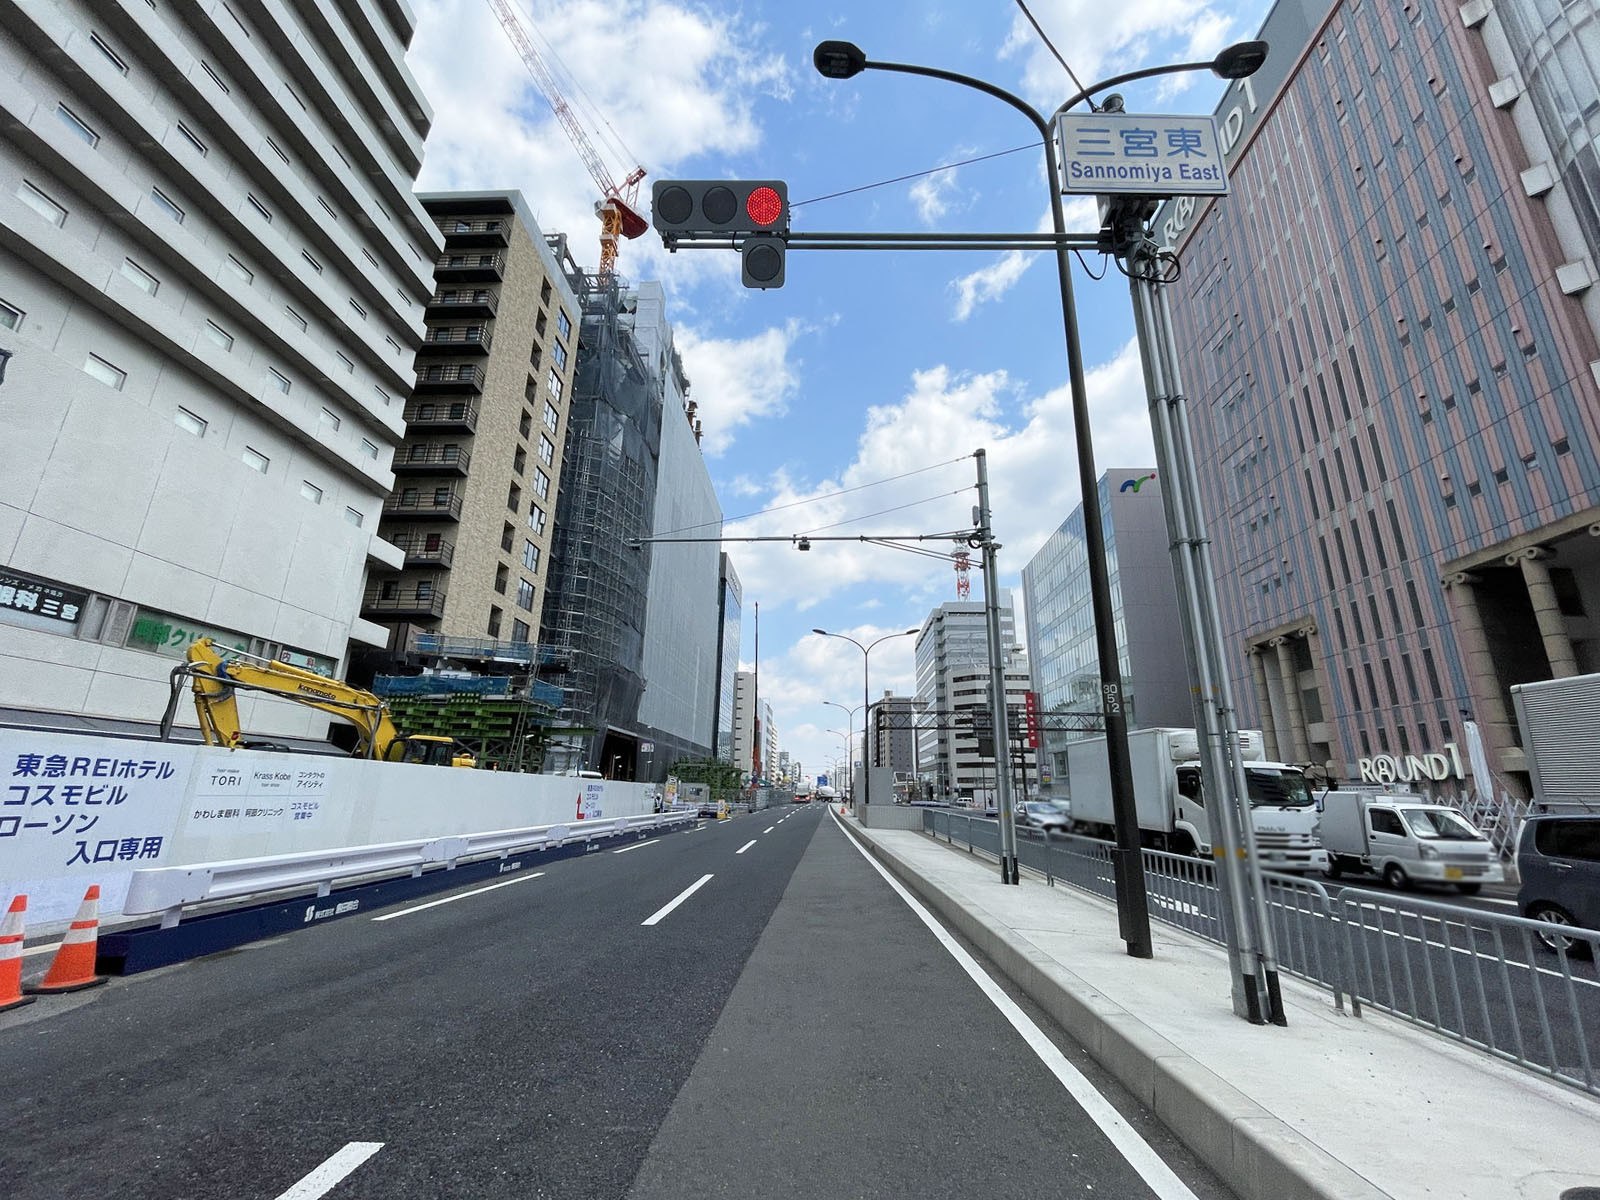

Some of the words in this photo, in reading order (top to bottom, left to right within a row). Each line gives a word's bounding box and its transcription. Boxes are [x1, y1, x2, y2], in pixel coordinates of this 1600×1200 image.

[1076, 128, 1207, 158] 三宮東
[1071, 161, 1172, 182] Sannomiya
[1179, 164, 1220, 180] East
[1103, 684, 1118, 694] 30
[1107, 693, 1115, 703] 5
[1107, 703, 1120, 713] 12
[12, 753, 175, 780] 東急REIホテル
[1358, 743, 1465, 783] ROUND1
[211, 776, 242, 786] TORI
[254, 772, 273, 780] Krass
[274, 772, 291, 781] Kobe
[3, 784, 128, 806] コスモビル
[194, 808, 240, 820] かわしま眼科
[291, 802, 320, 810] コスモビル
[0, 814, 99, 837] ローソン
[66, 836, 163, 866] 入口専用
